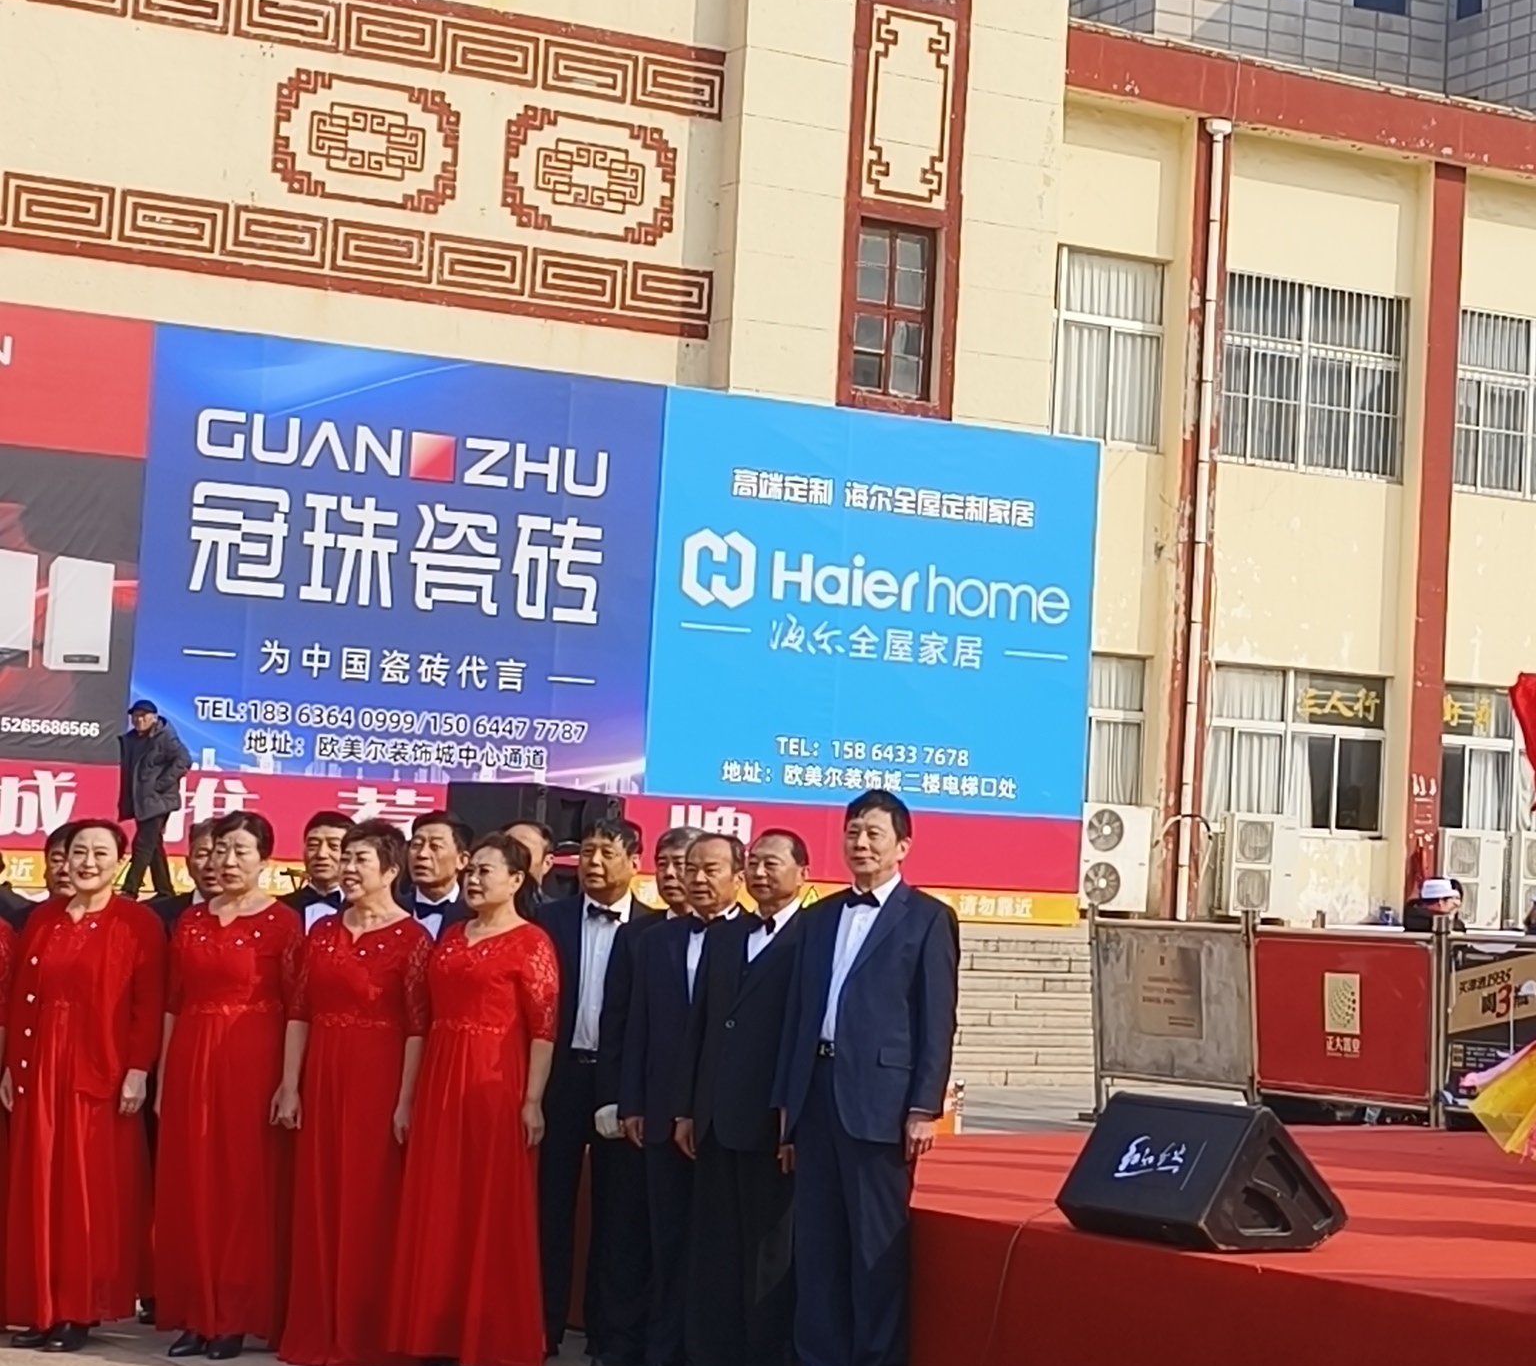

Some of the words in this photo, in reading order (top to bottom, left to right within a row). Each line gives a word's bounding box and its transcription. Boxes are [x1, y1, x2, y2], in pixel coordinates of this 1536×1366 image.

[731, 467, 834, 507] 高端定制
[844, 480, 1036, 529] 海尔全屋定制家居
[187, 480, 605, 625] 冠珠瓷砖
[770, 550, 920, 612] Haier
[926, 563, 1071, 626] home
[259, 639, 528, 692] 为中国瓷砖代言
[768, 613, 985, 670] 海尔全屋家居
[297, 704, 353, 729] 6364
[360, 709, 468, 736] 0999/150
[474, 718, 527, 740] 6447
[533, 721, 589, 744] 7787
[832, 740, 866, 761] 158
[871, 742, 918, 764] 6433
[923, 746, 970, 768] 7678
